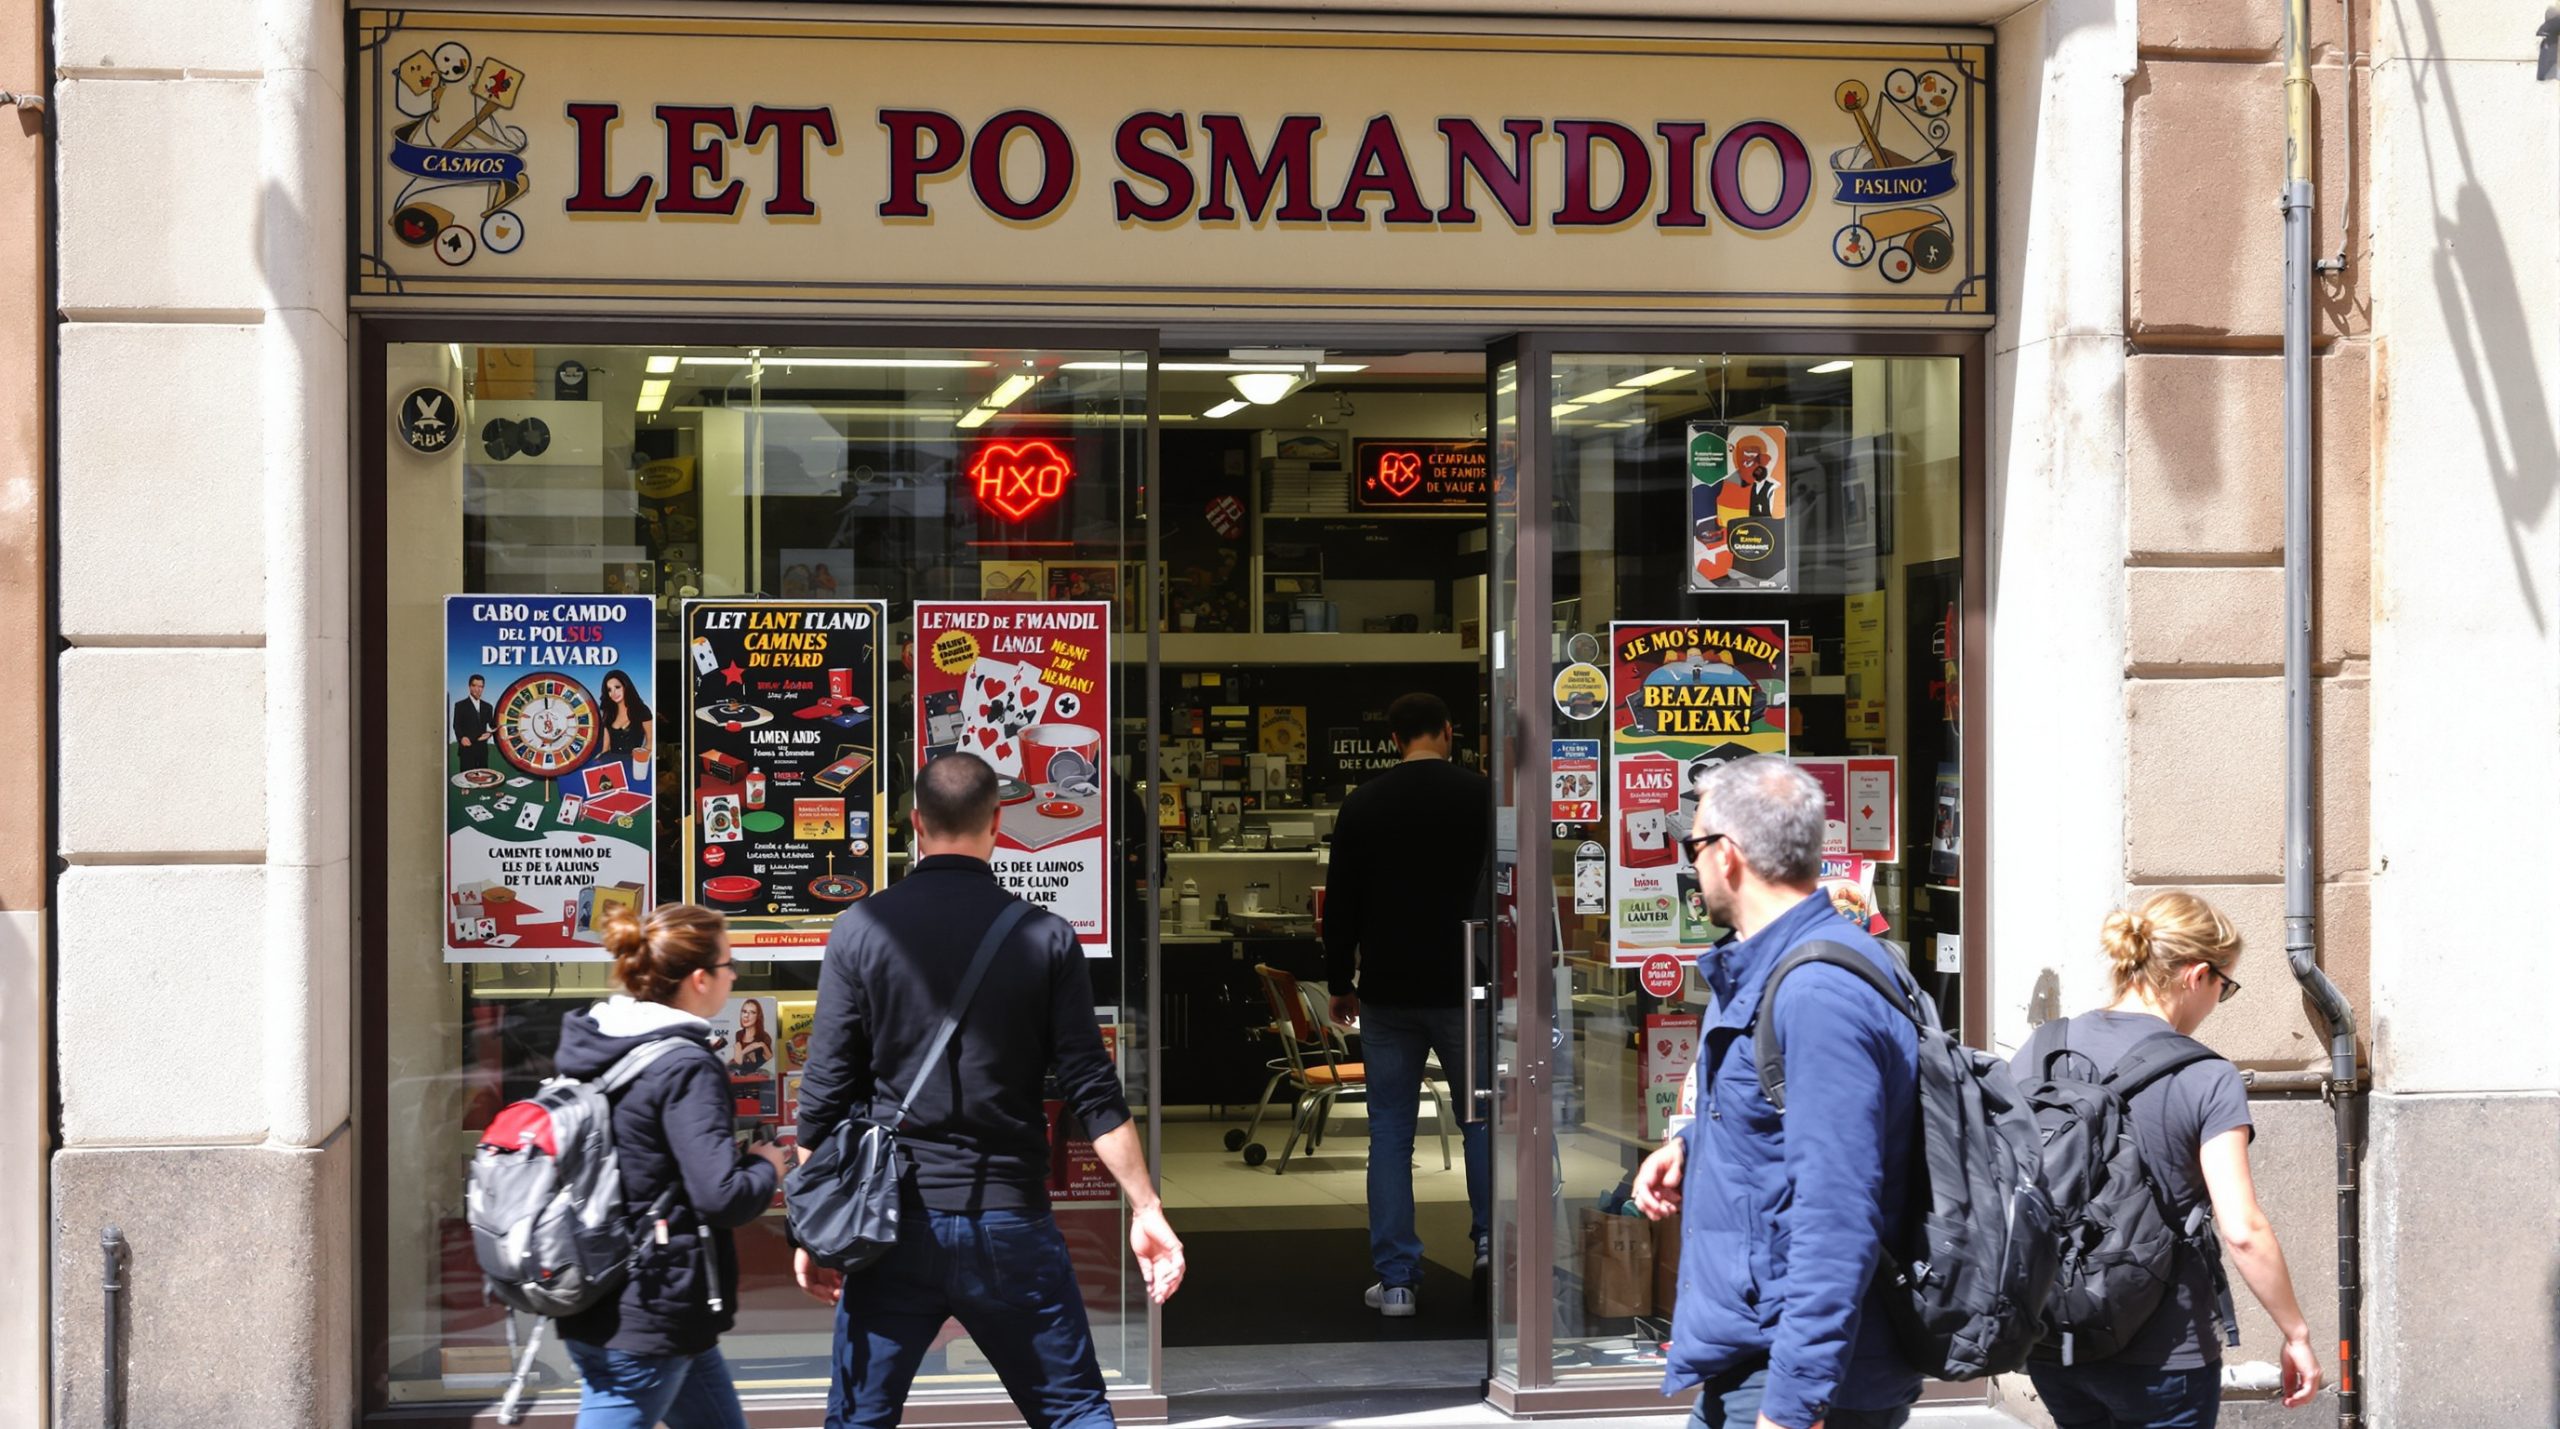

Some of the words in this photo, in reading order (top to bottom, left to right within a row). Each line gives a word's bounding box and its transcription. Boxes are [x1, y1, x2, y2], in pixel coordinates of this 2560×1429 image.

[422, 154, 505, 174] CASMOS
[564, 103, 839, 217] LET
[1113, 111, 1812, 231] SMANDIO
[979, 465, 1062, 498] HXO
[472, 604, 529, 622] CABO
[533, 610, 550, 622] DE
[552, 604, 627, 622] CAMDO
[705, 612, 747, 630] LET
[748, 612, 801, 630] LANT
[993, 616, 1010, 629] DE
[744, 633, 828, 650] CAMNES
[1624, 638, 1650, 661] JE
[1651, 627, 1700, 649] MO'S
[482, 646, 526, 665] DET
[530, 646, 618, 665] LAVARD
[749, 653, 770, 667] DU
[773, 652, 824, 667] EVARD
[1643, 686, 1755, 708] BEAZAIN
[1656, 709, 1751, 733] PLEAK!
[750, 730, 789, 744] LAMEN
[1624, 772, 1673, 790] LAMS
[597, 848, 611, 858] DE
[1009, 876, 1024, 887] DE
[1026, 891, 1058, 902] CARE
